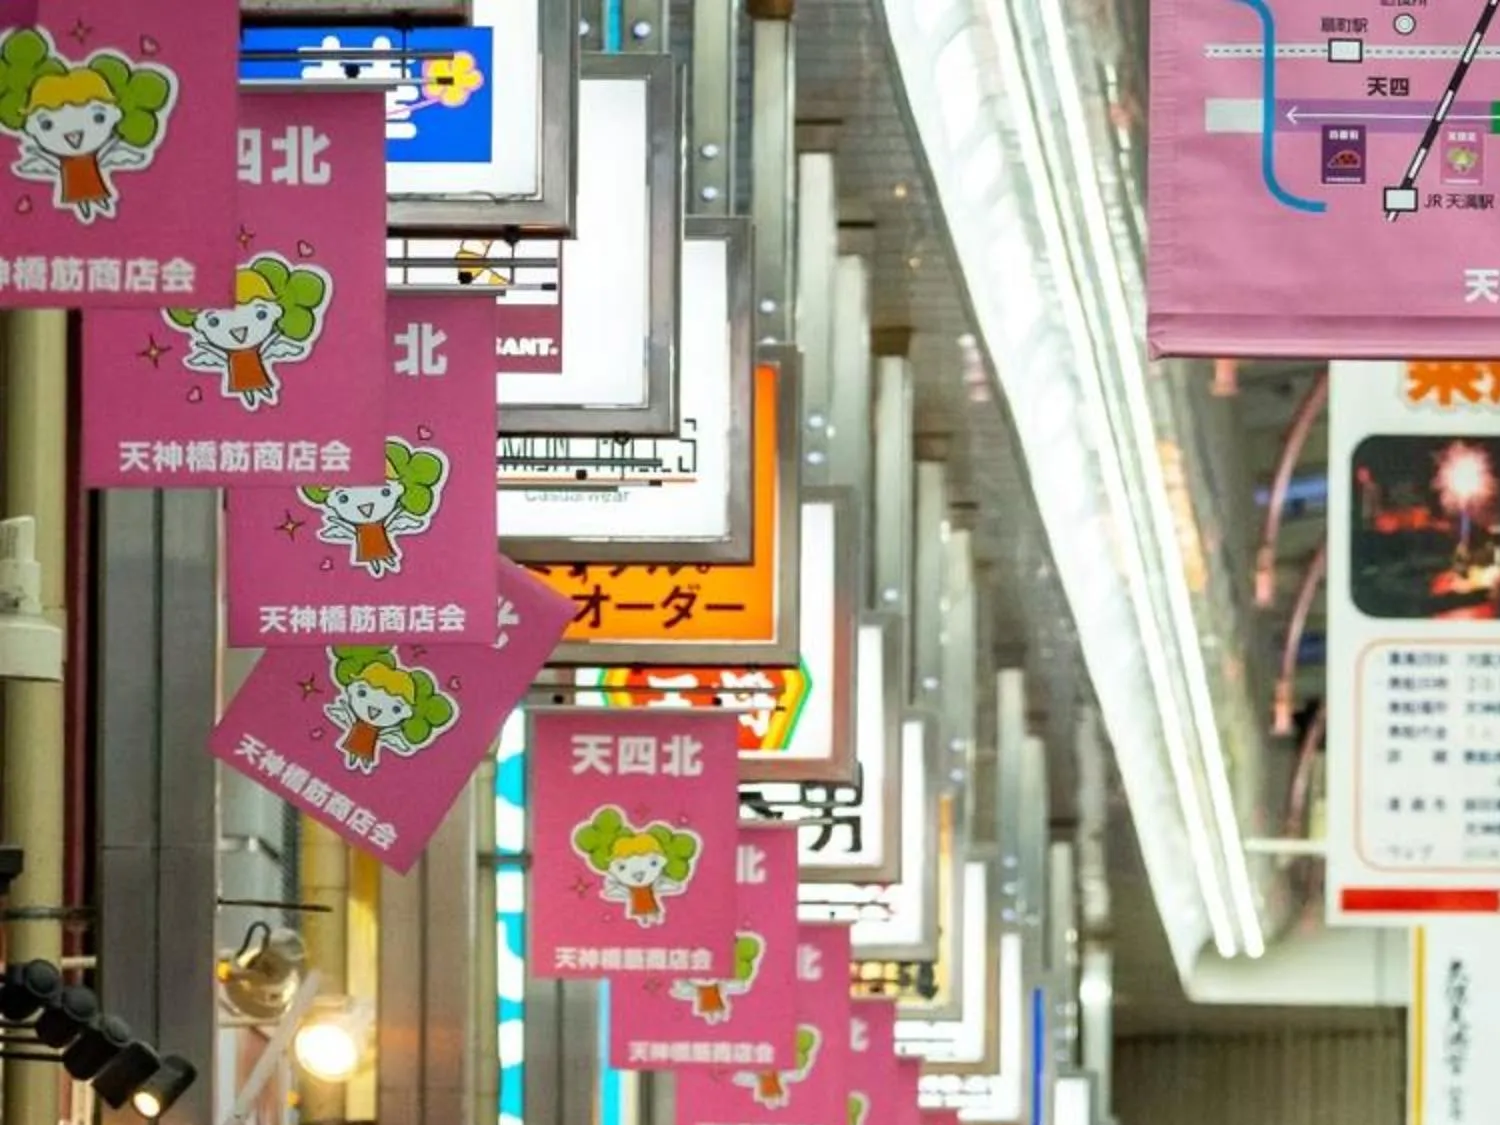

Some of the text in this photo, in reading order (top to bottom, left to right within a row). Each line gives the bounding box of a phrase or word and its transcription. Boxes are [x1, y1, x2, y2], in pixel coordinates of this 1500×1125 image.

[1367, 76, 1410, 97] 天四
[1424, 194, 1443, 209] JR
[0, 256, 197, 293] 橋筋商店会
[118, 440, 352, 473] 天神橋筋商店会
[258, 604, 466, 634] 天神橋筋商店会
[573, 584, 746, 628] オーダー
[571, 733, 704, 777] 天四北
[234, 732, 398, 851] 天神橋筋商店会
